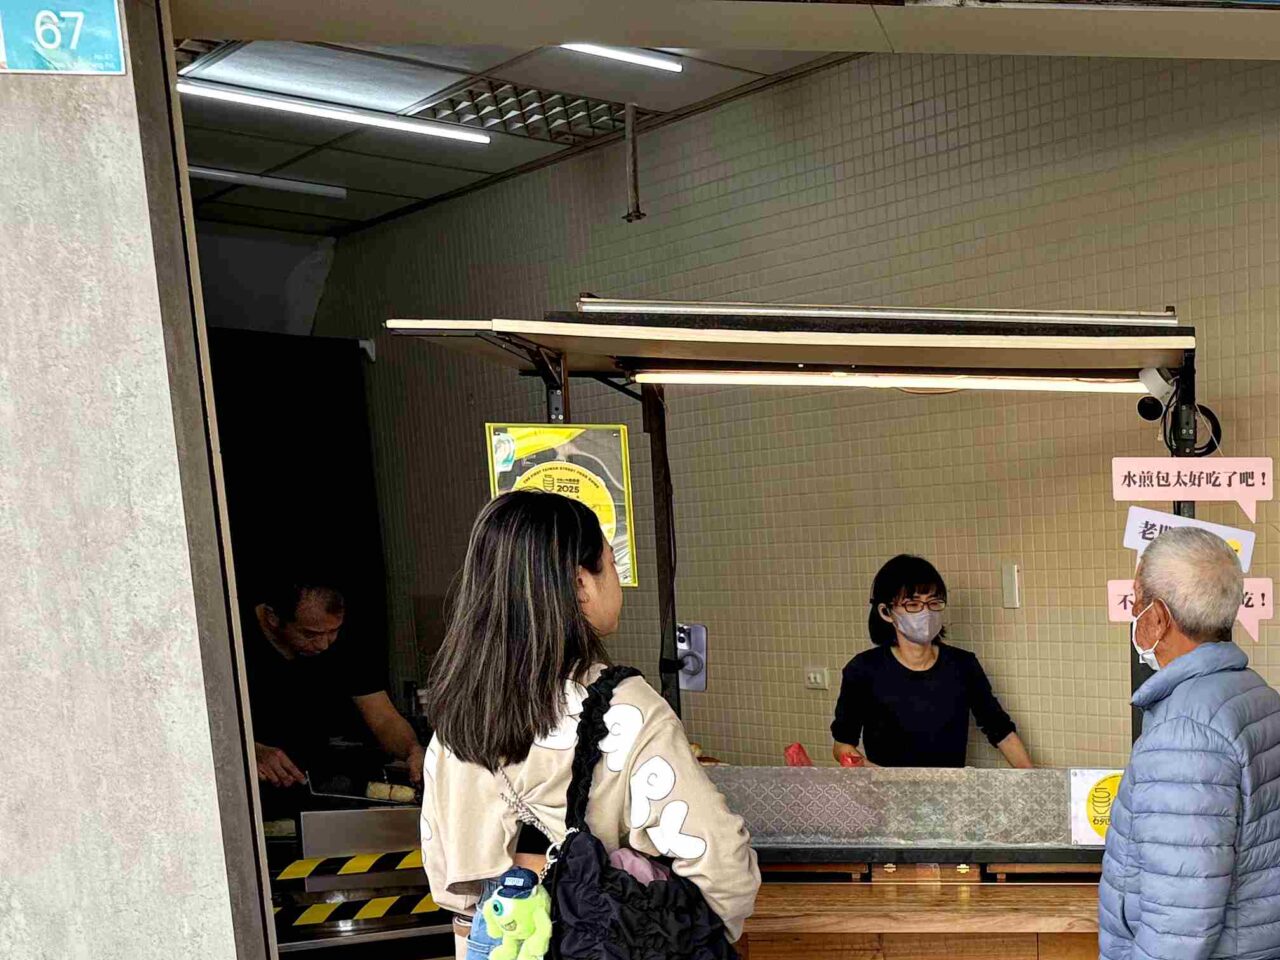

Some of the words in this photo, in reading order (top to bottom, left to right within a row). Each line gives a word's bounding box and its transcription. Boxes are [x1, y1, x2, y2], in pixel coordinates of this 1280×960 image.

[35, 9, 85, 50] 67
[1121, 470, 1267, 488] 水煎包太好吃了吧！
[556, 485, 580, 493] 2025
